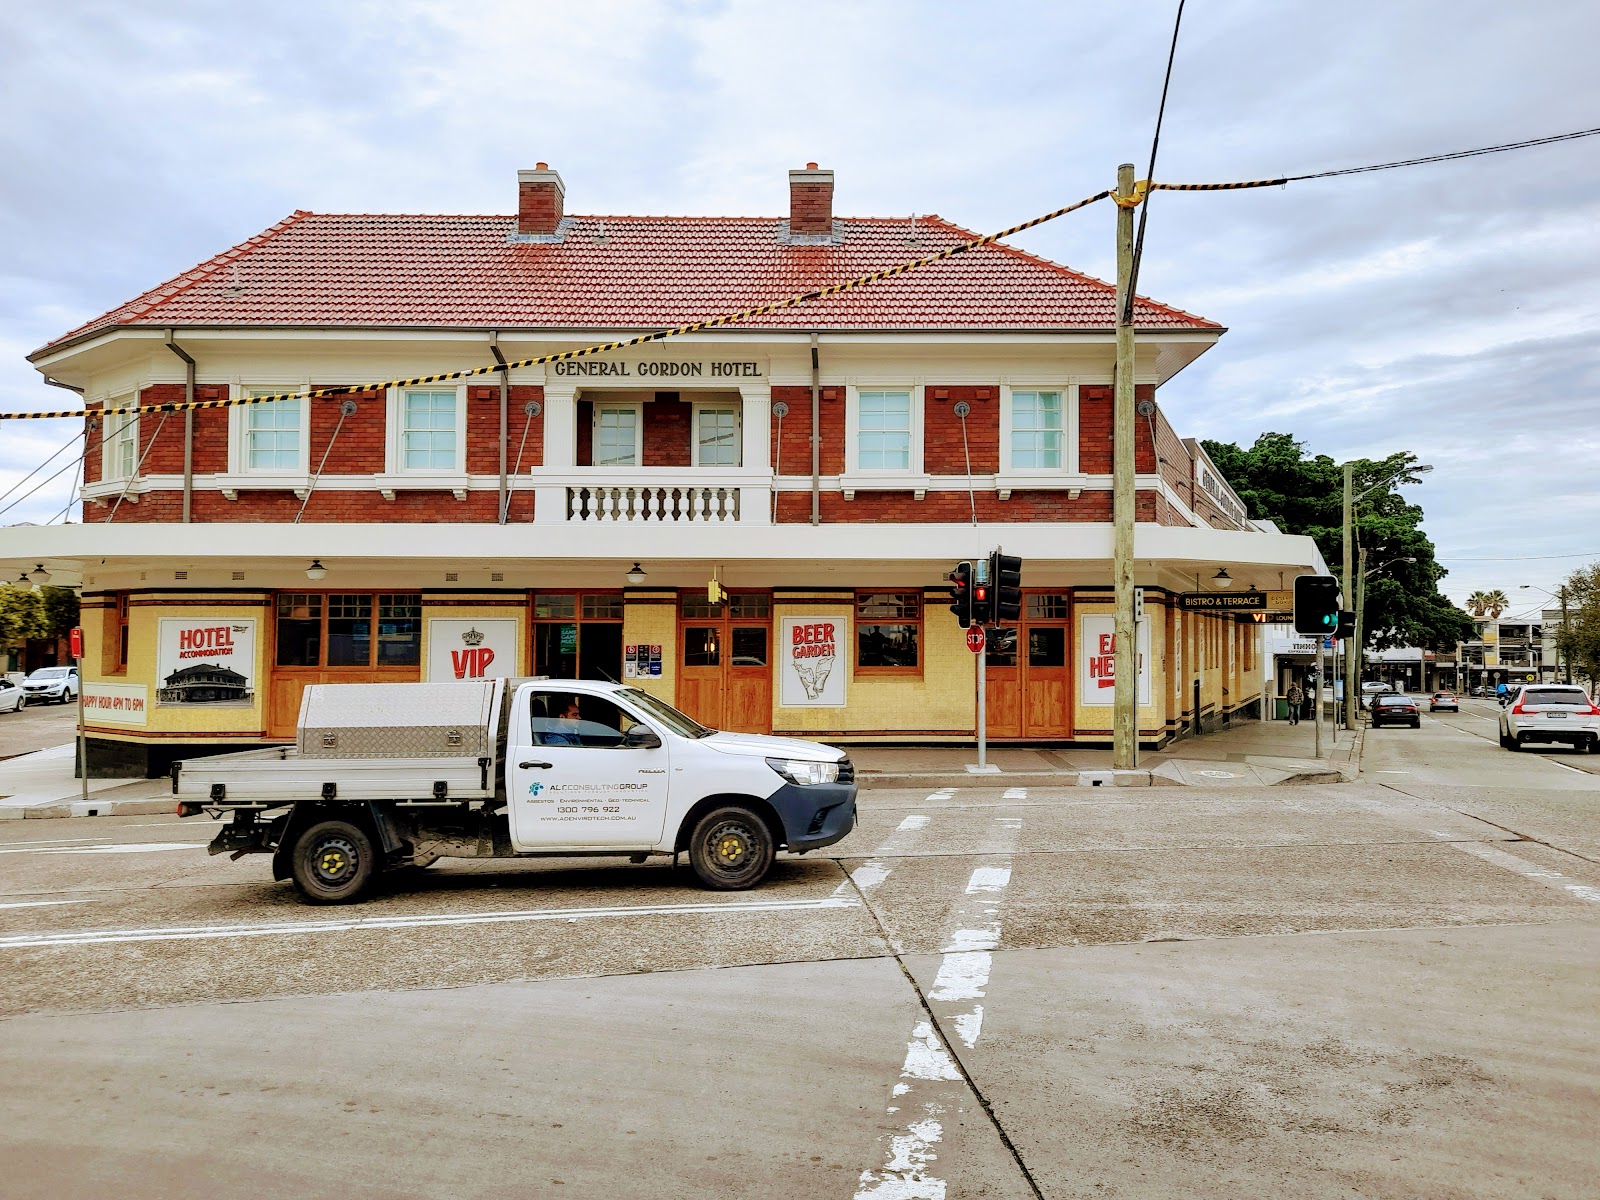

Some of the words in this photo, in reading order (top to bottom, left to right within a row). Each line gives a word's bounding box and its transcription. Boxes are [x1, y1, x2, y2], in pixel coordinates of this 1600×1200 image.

[555, 362, 630, 376] GENERAL
[637, 362, 702, 376] GORDON
[711, 362, 762, 376] HOTEL
[1185, 598, 1214, 606] BISTRO
[1223, 597, 1260, 605] TERRACE
[180, 626, 235, 649] HOTEL
[792, 623, 835, 645] BEER
[967, 634, 984, 644] STOP
[792, 644, 835, 659] GARDEN
[1099, 633, 1117, 655] EA
[179, 647, 233, 659] ACCOMMODATION
[451, 647, 495, 680] VIP
[82, 695, 97, 708] HAPPY
[98, 696, 112, 709] HOUR
[113, 697, 123, 710] 4PM
[125, 698, 132, 711] TO
[133, 698, 144, 712] 6PM
